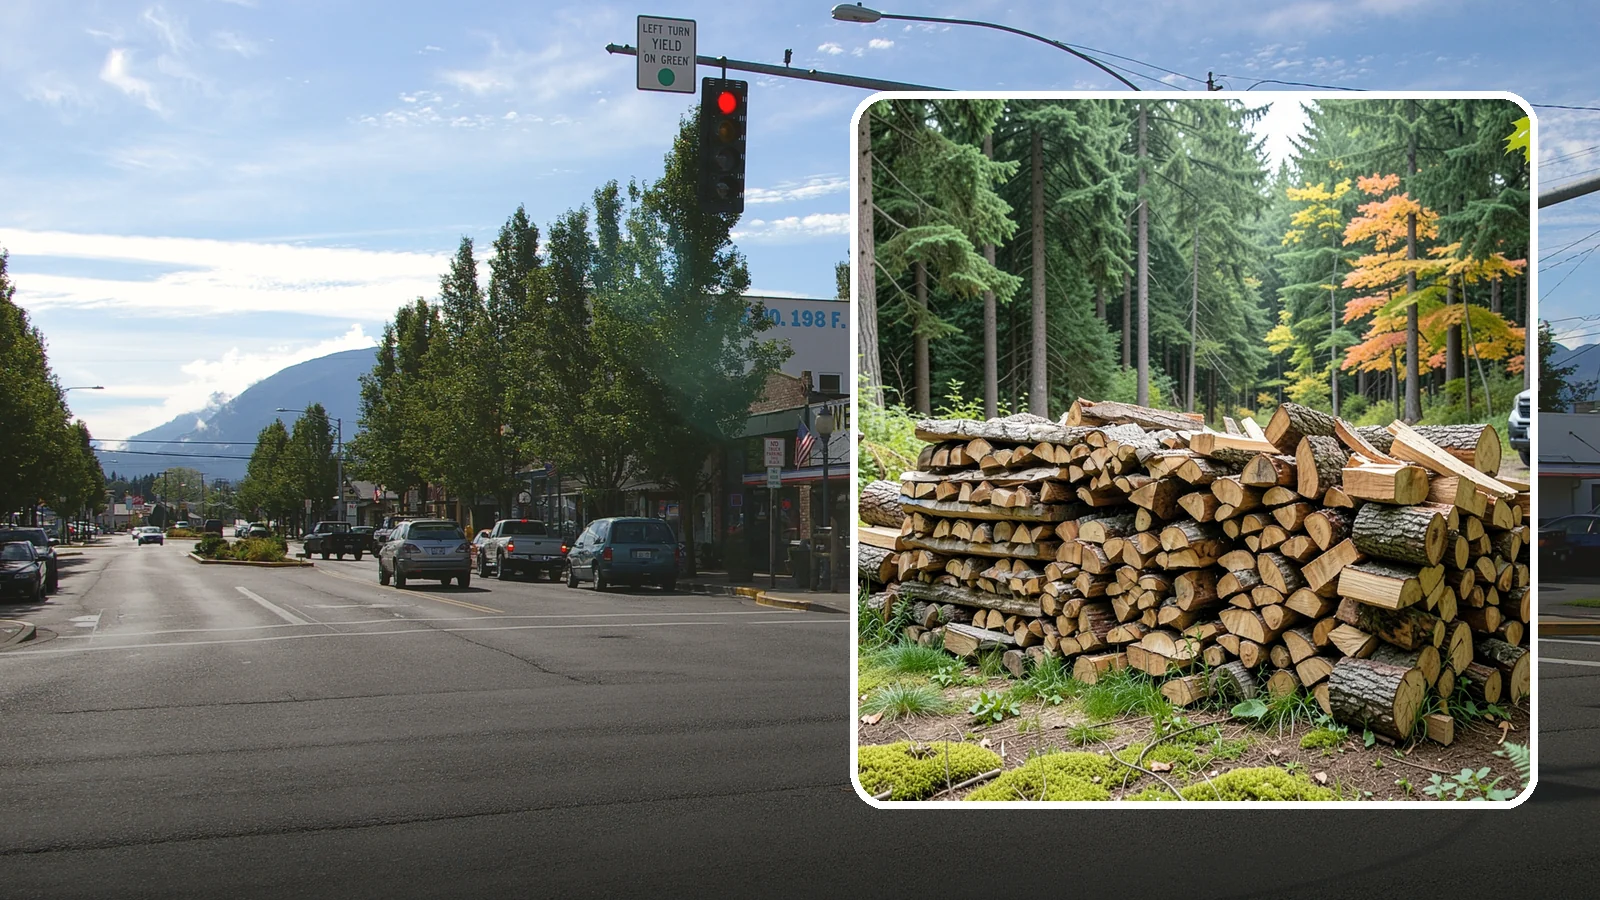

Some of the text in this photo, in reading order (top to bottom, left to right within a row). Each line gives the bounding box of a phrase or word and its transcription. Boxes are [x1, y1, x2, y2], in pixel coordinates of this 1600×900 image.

[643, 23, 690, 36] LEFT TURN
[652, 38, 682, 51] YIELD
[644, 53, 689, 66] ON GREEN
[791, 309, 826, 328] 198
[831, 311, 846, 329] F.
